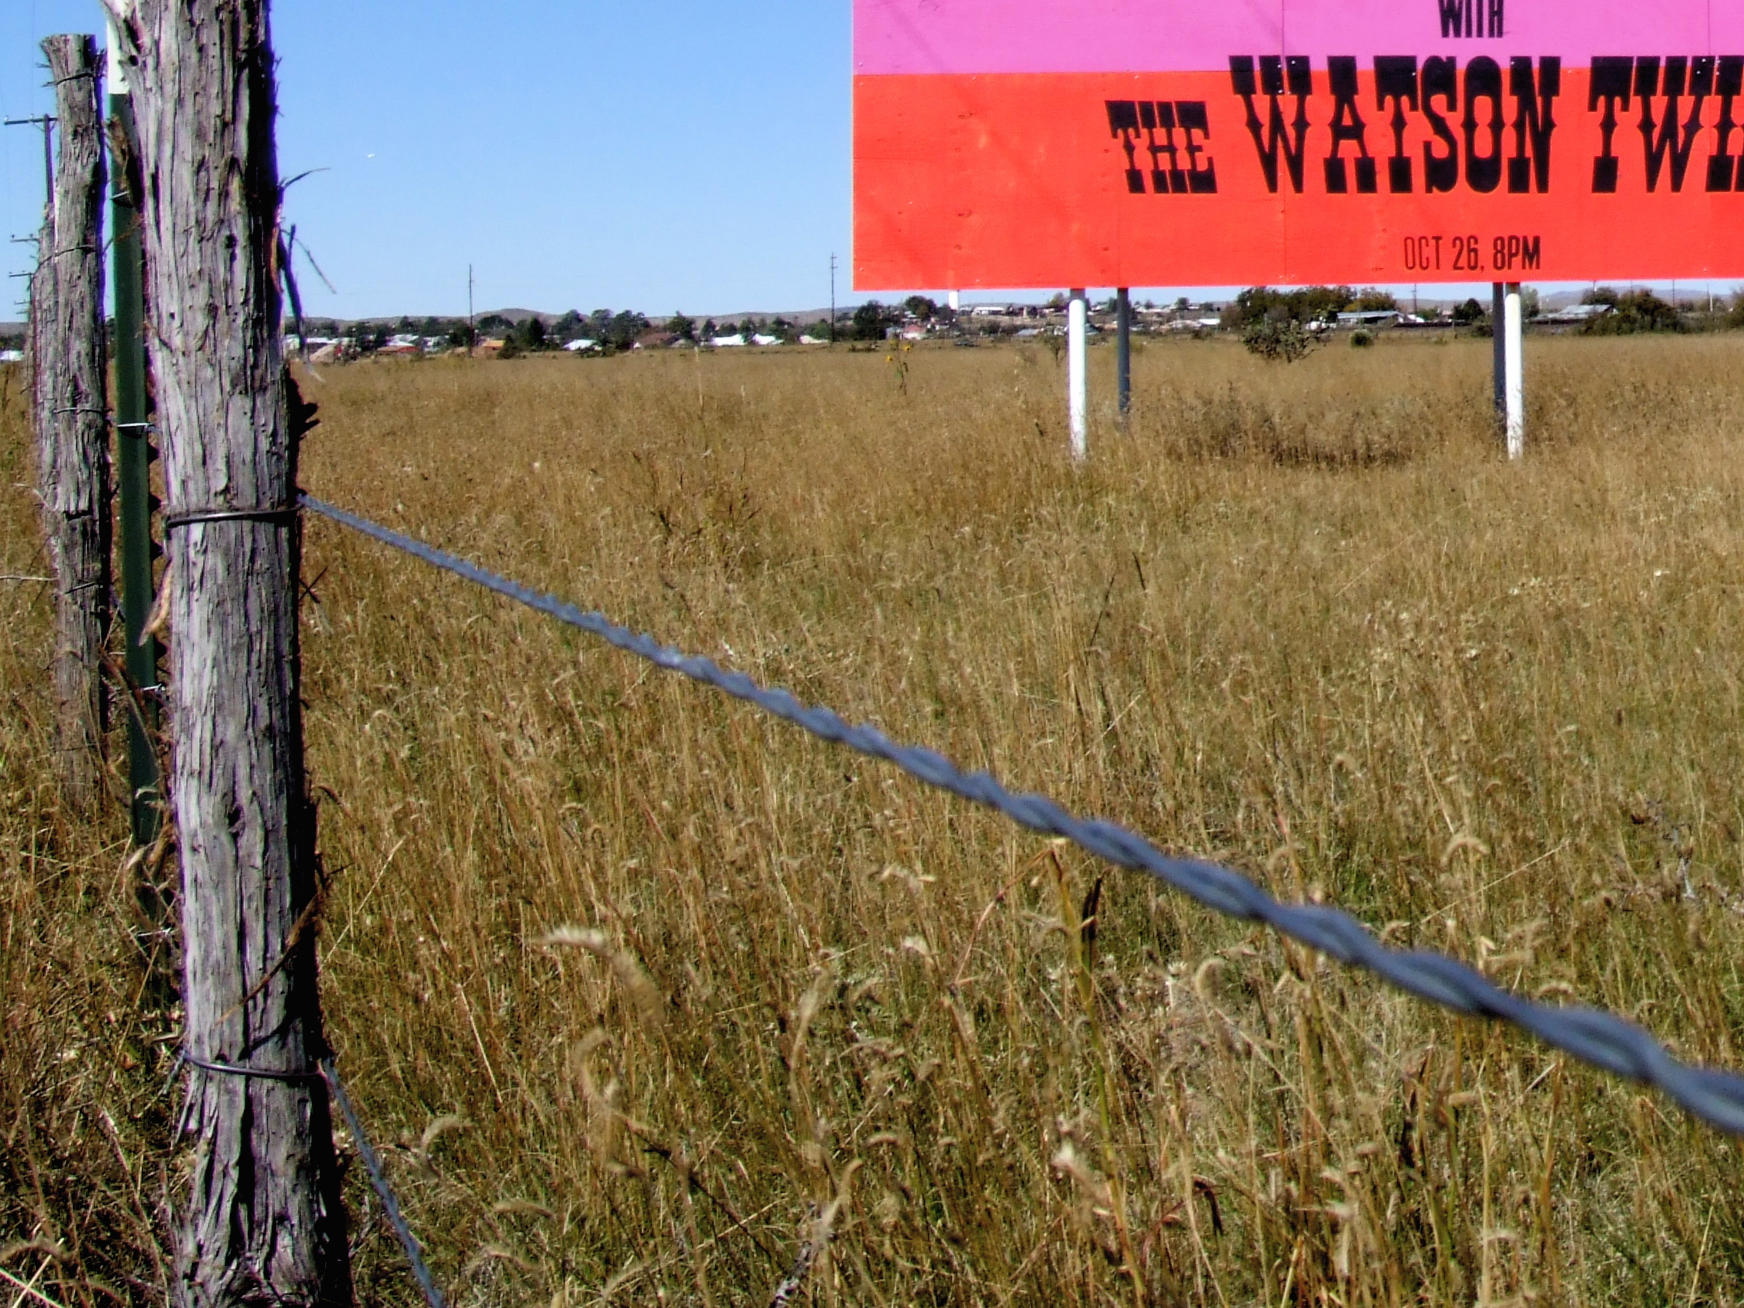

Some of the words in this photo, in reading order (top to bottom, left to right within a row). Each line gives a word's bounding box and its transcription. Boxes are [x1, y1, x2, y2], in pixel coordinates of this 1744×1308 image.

[1105, 100, 1217, 194] THE
[1228, 55, 1561, 194] WATSON
[1403, 235, 1443, 271] OCT
[1492, 235, 1542, 271] 8PM
